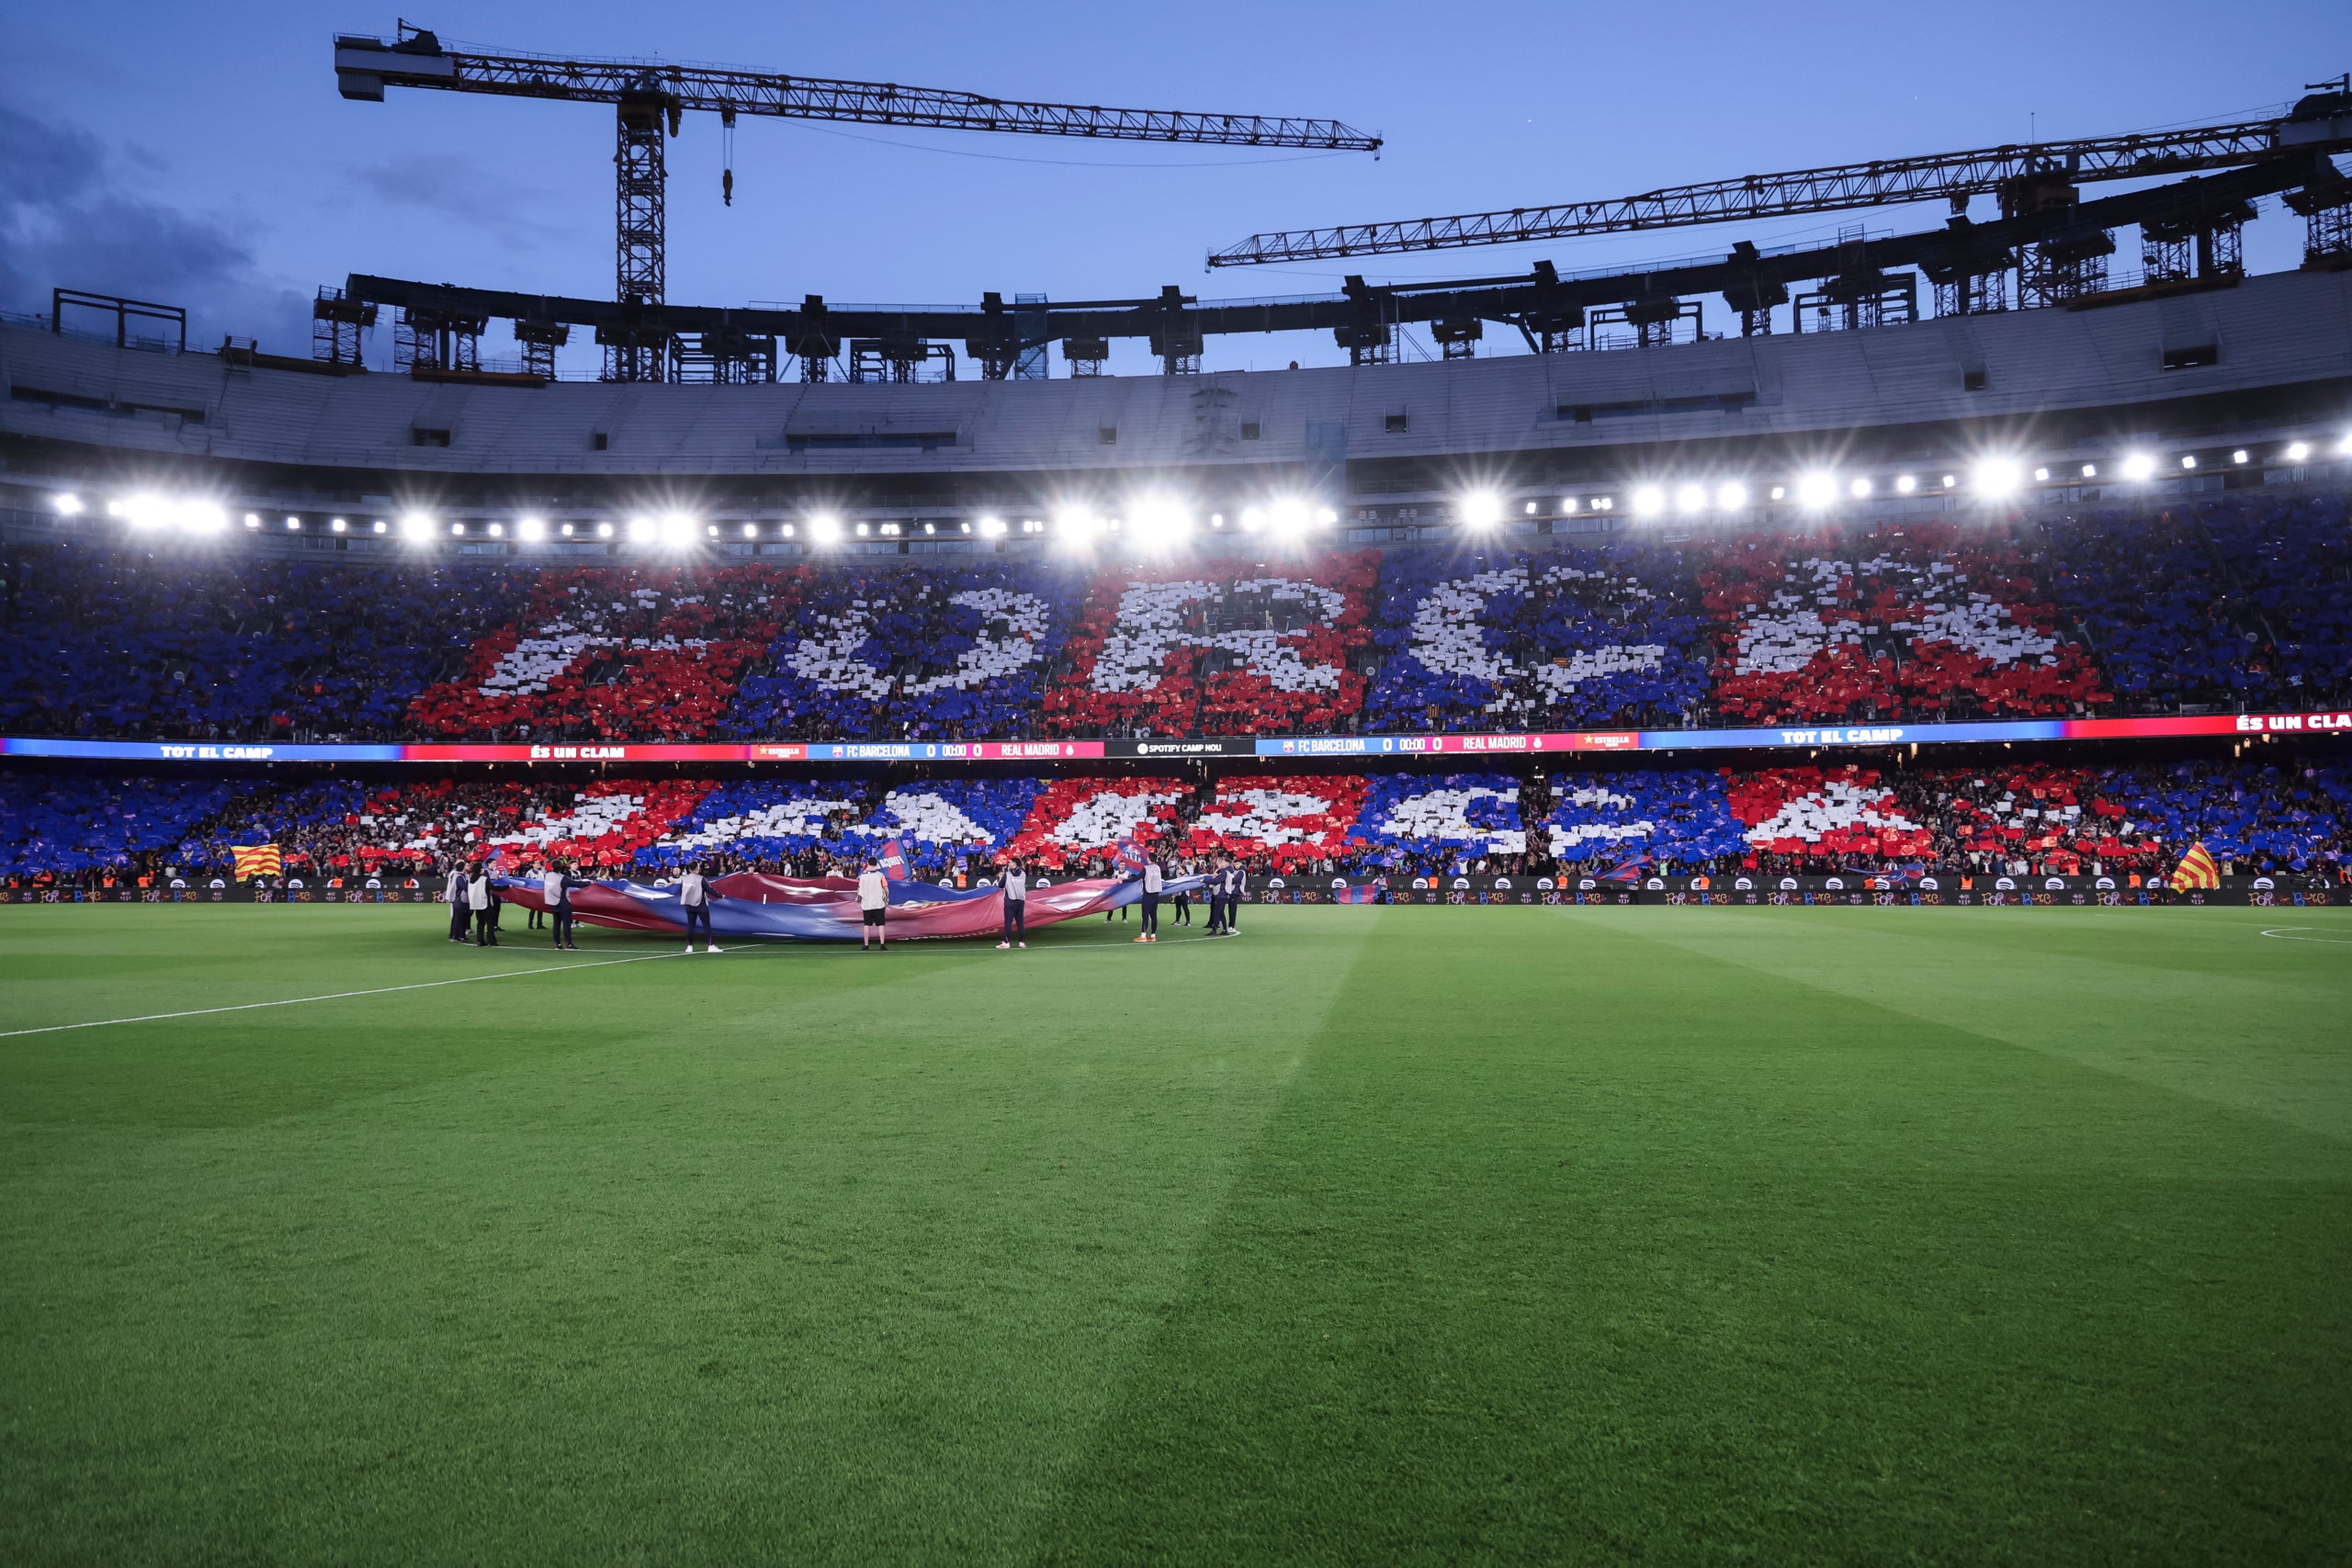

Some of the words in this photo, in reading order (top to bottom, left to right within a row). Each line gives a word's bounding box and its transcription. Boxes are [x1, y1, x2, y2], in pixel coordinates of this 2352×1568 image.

[2236, 715, 2264, 730] ÉS
[2268, 716, 2302, 729] UN
[1594, 736, 1630, 744] ESTRELLA
[1781, 731, 1817, 744] TOT
[1820, 730, 1843, 743] EL
[1847, 728, 1904, 743] CAMP
[846, 746, 858, 758] FC
[859, 745, 910, 758] BARCELONA
[926, 744, 936, 758] 0
[942, 745, 967, 757] 00:00
[973, 744, 983, 757] 0
[1001, 744, 1023, 756] REAL
[1024, 744, 1059, 756] MADRID
[1148, 744, 1182, 753] SPOTIFY
[1182, 744, 1204, 752] CAMP
[1204, 743, 1222, 752] NOU
[1298, 739, 1310, 752] FC
[1311, 739, 1365, 752] BARCELONA
[1383, 739, 1393, 751] 0
[1399, 738, 1426, 750] 00:00
[1432, 738, 1442, 750] 0
[1463, 737, 1487, 750] REAL
[1487, 736, 1527, 750] MADRID
[160, 746, 196, 758] TOT
[198, 747, 220, 759] EL
[222, 747, 274, 759] CAMP
[530, 745, 551, 759] ÉS
[553, 747, 577, 759] UN
[580, 747, 625, 759] CLAM
